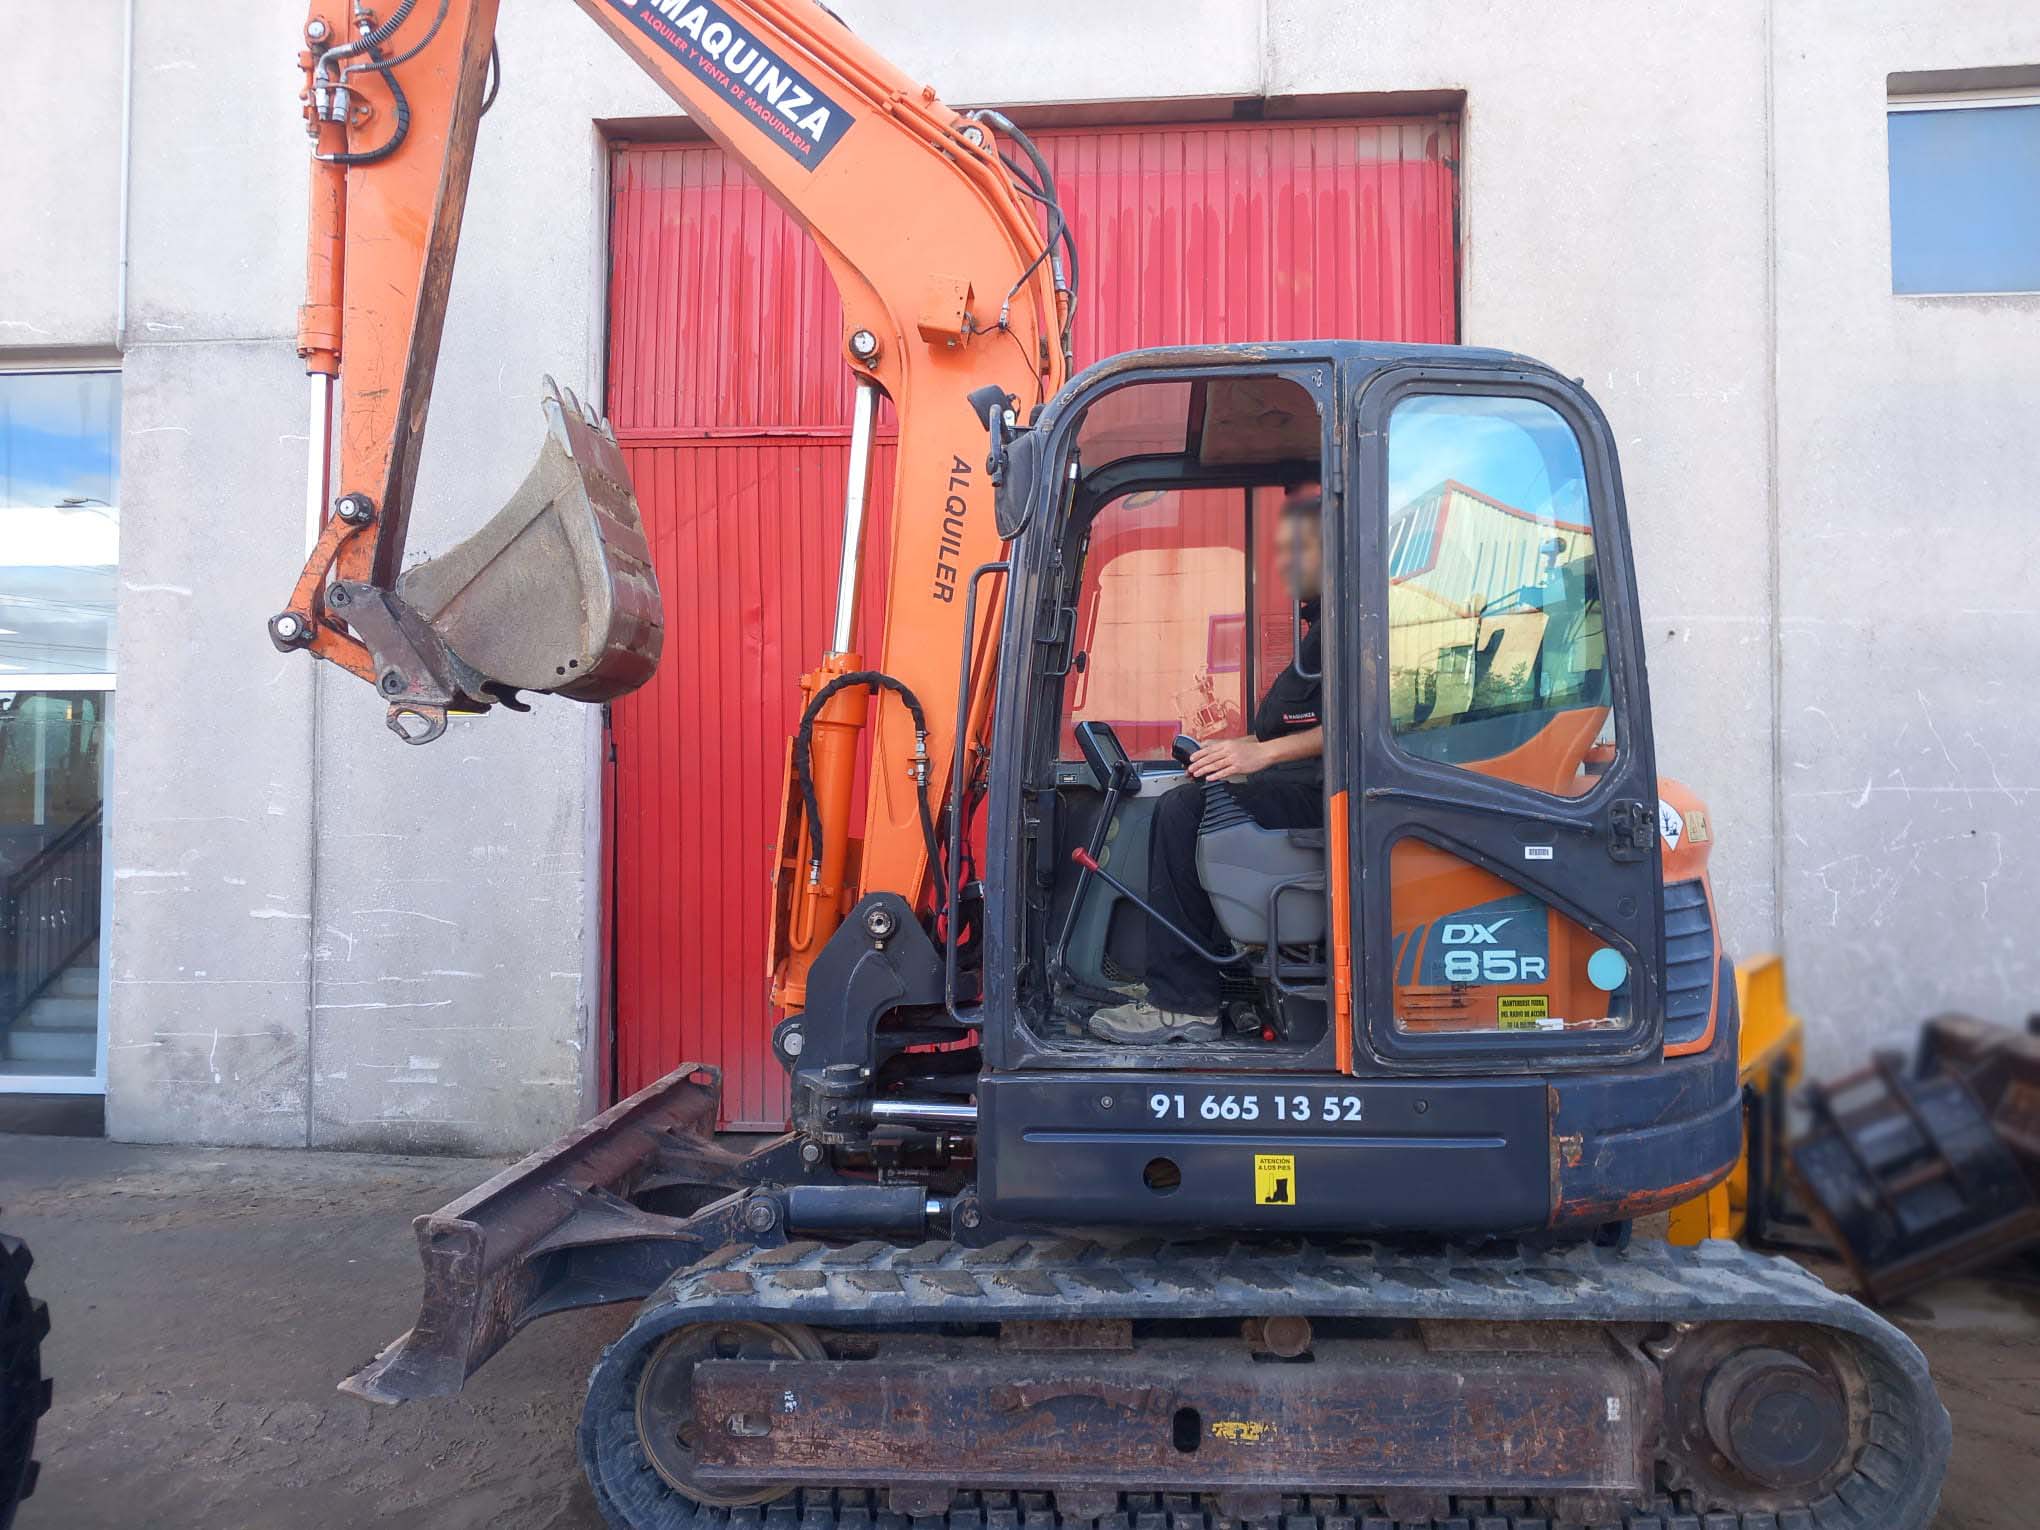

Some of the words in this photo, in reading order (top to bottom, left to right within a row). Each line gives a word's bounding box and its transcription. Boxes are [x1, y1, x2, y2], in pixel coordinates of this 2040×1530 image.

[640, 10, 688, 53] ALQUILER
[688, 47, 698, 59] Y
[698, 55, 730, 88] VENTA
[730, 83, 746, 100] DE
[744, 96, 812, 155] MAQUINARIA
[933, 455, 972, 603] ALQUILER
[1441, 918, 1514, 944] DX
[1444, 950, 1547, 982] 85R
[1150, 1094, 1185, 1119] 91
[1200, 1095, 1259, 1120] 665
[1274, 1096, 1311, 1121] 13
[1322, 1096, 1362, 1121] 52
